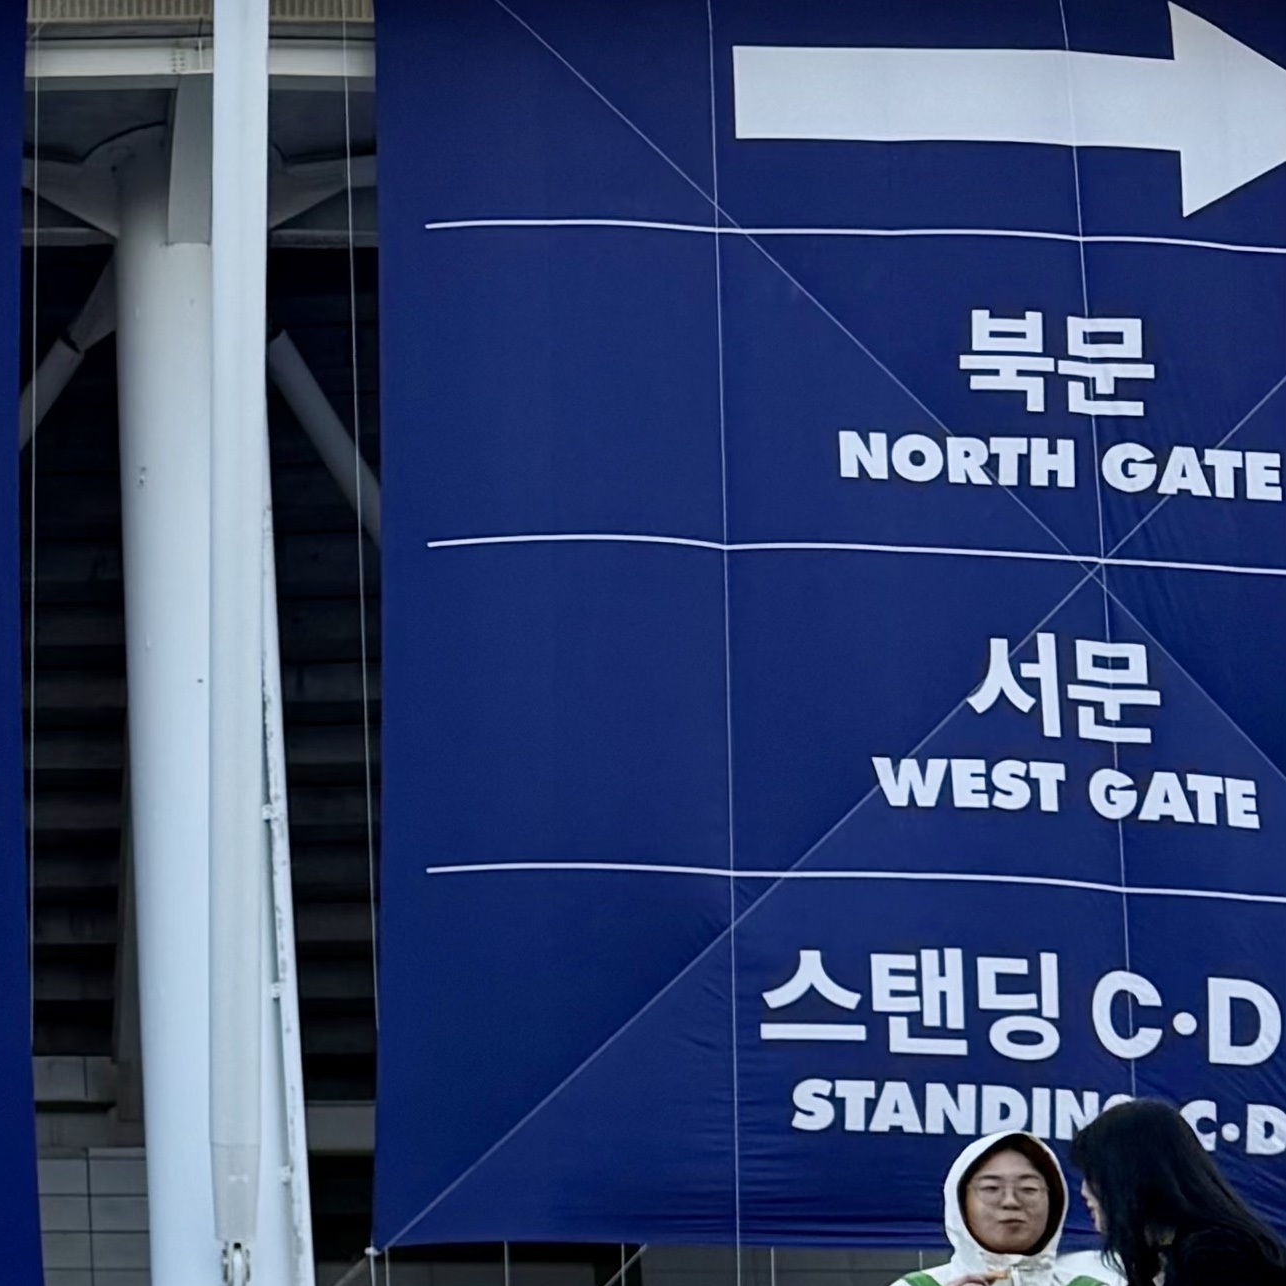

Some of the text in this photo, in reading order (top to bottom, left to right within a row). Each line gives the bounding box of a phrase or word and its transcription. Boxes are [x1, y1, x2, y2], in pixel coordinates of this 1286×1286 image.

[961, 311, 1155, 416] 북문
[840, 432, 1282, 501] NORTH GATE
[968, 634, 1161, 744] 서문
[873, 758, 1260, 829] WEST GATE
[762, 950, 1060, 1060] 스탠딩
